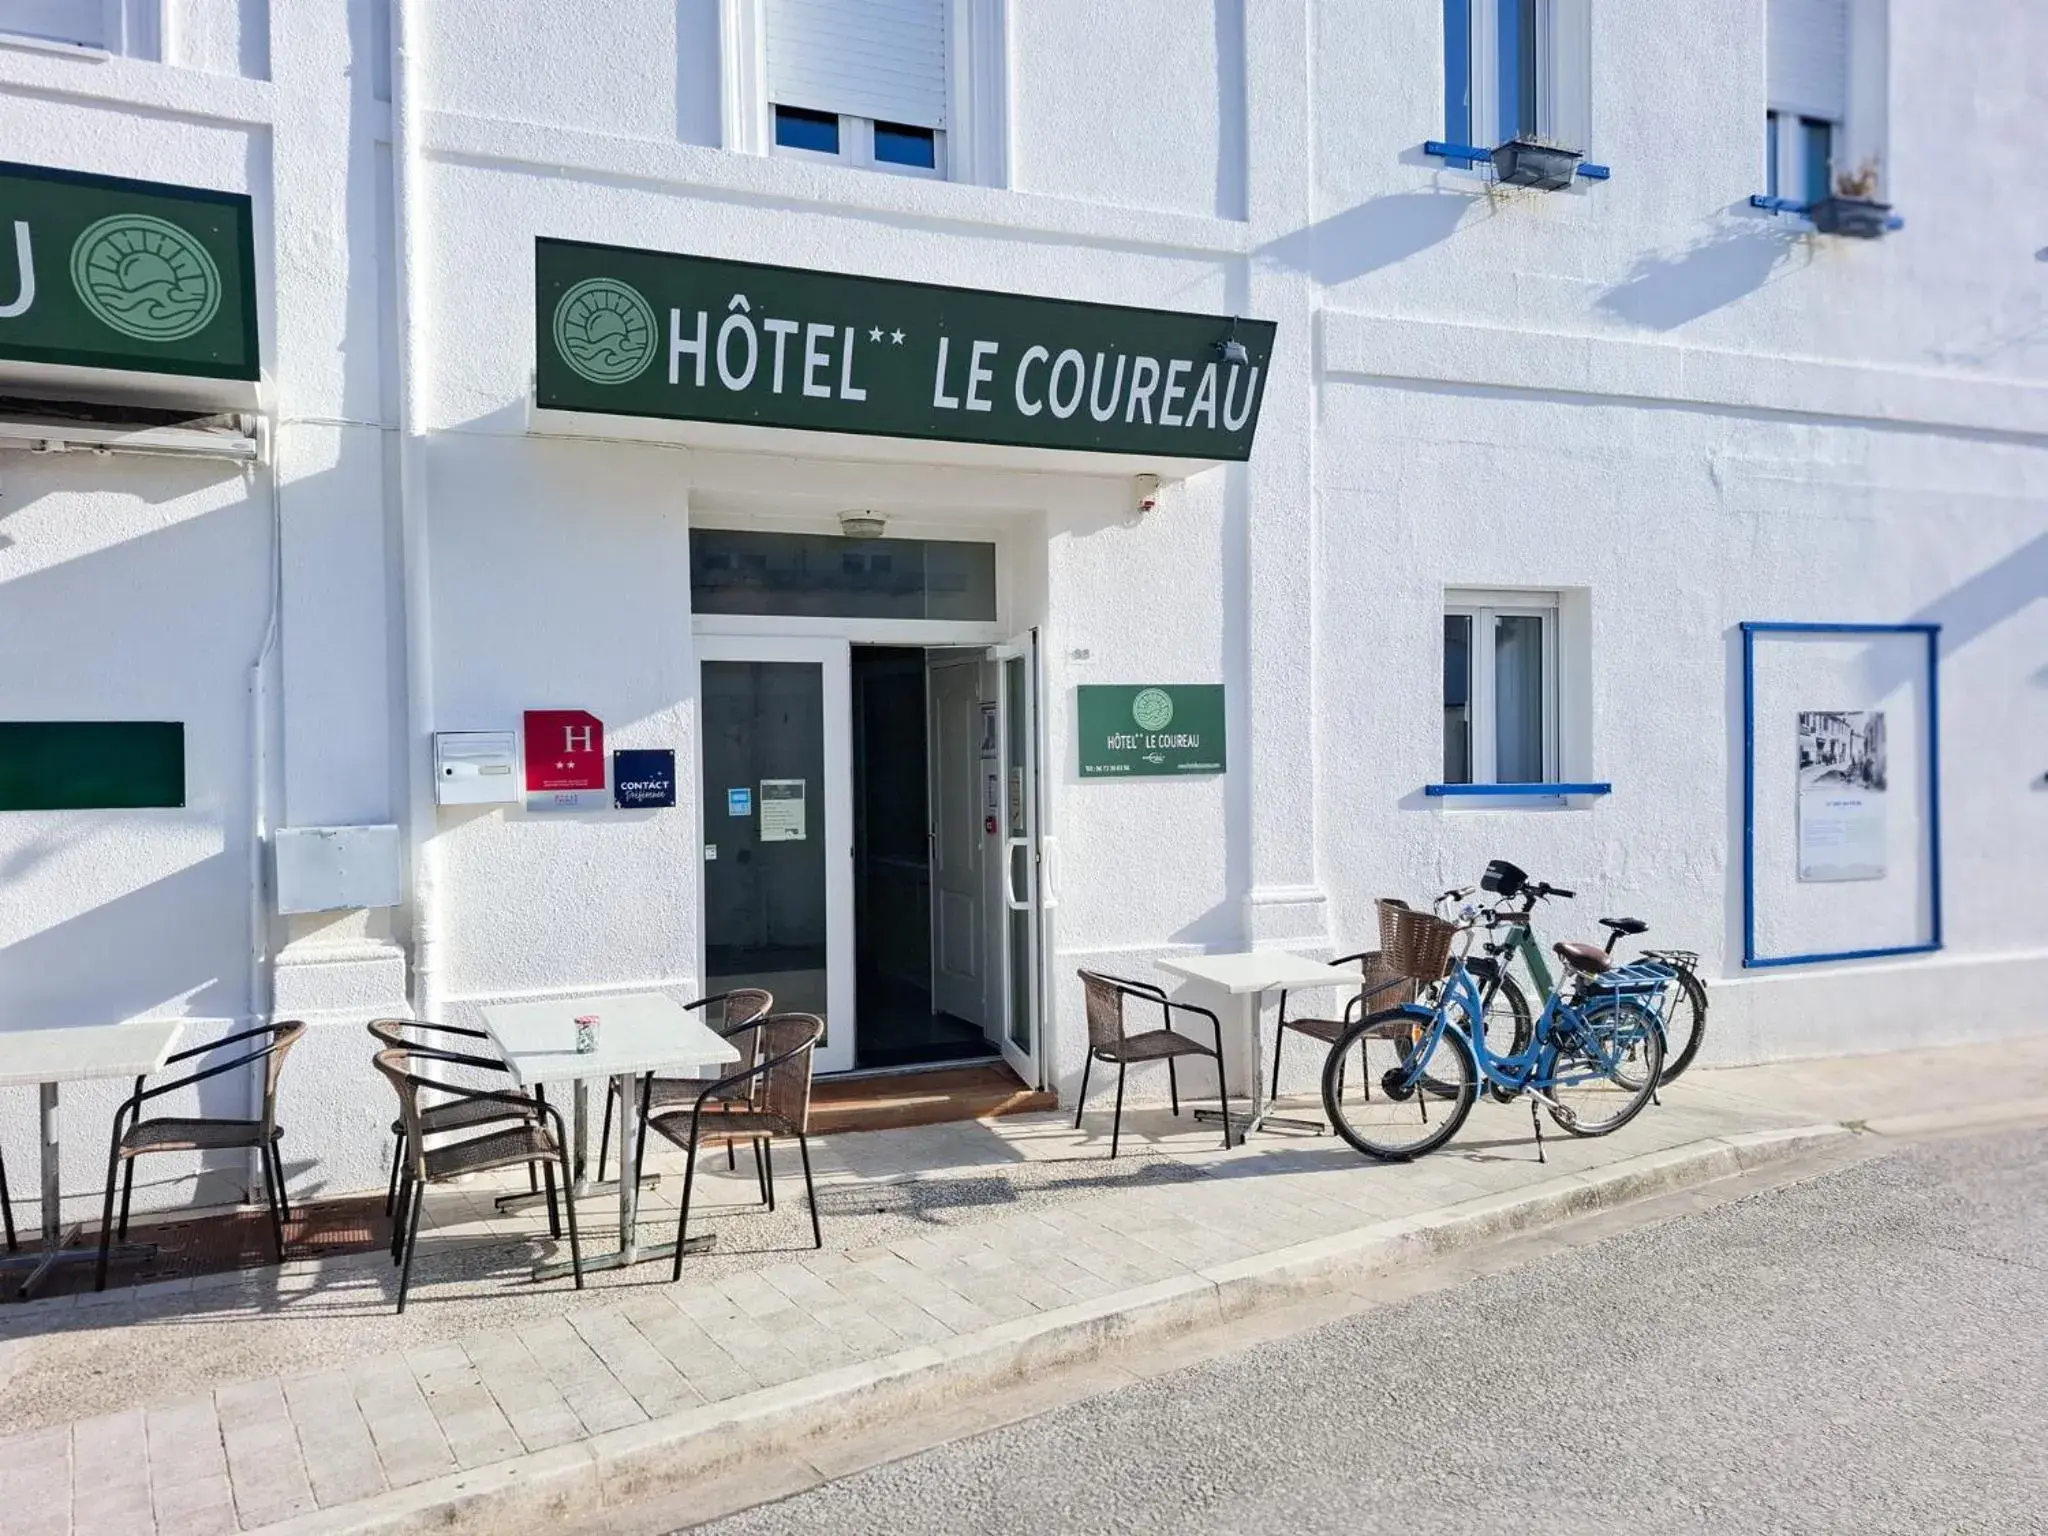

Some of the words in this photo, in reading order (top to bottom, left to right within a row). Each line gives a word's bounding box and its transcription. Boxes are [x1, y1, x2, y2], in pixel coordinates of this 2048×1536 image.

[668, 294, 867, 401] HÔTEL
[933, 336, 999, 412] LE
[1015, 344, 1258, 432] COUREAU
[565, 726, 592, 752] H
[1107, 732, 1137, 750] HÔTEL
[1146, 734, 1156, 749] LE
[1158, 733, 1200, 749] COUREAU
[620, 780, 670, 790] CONTACT
